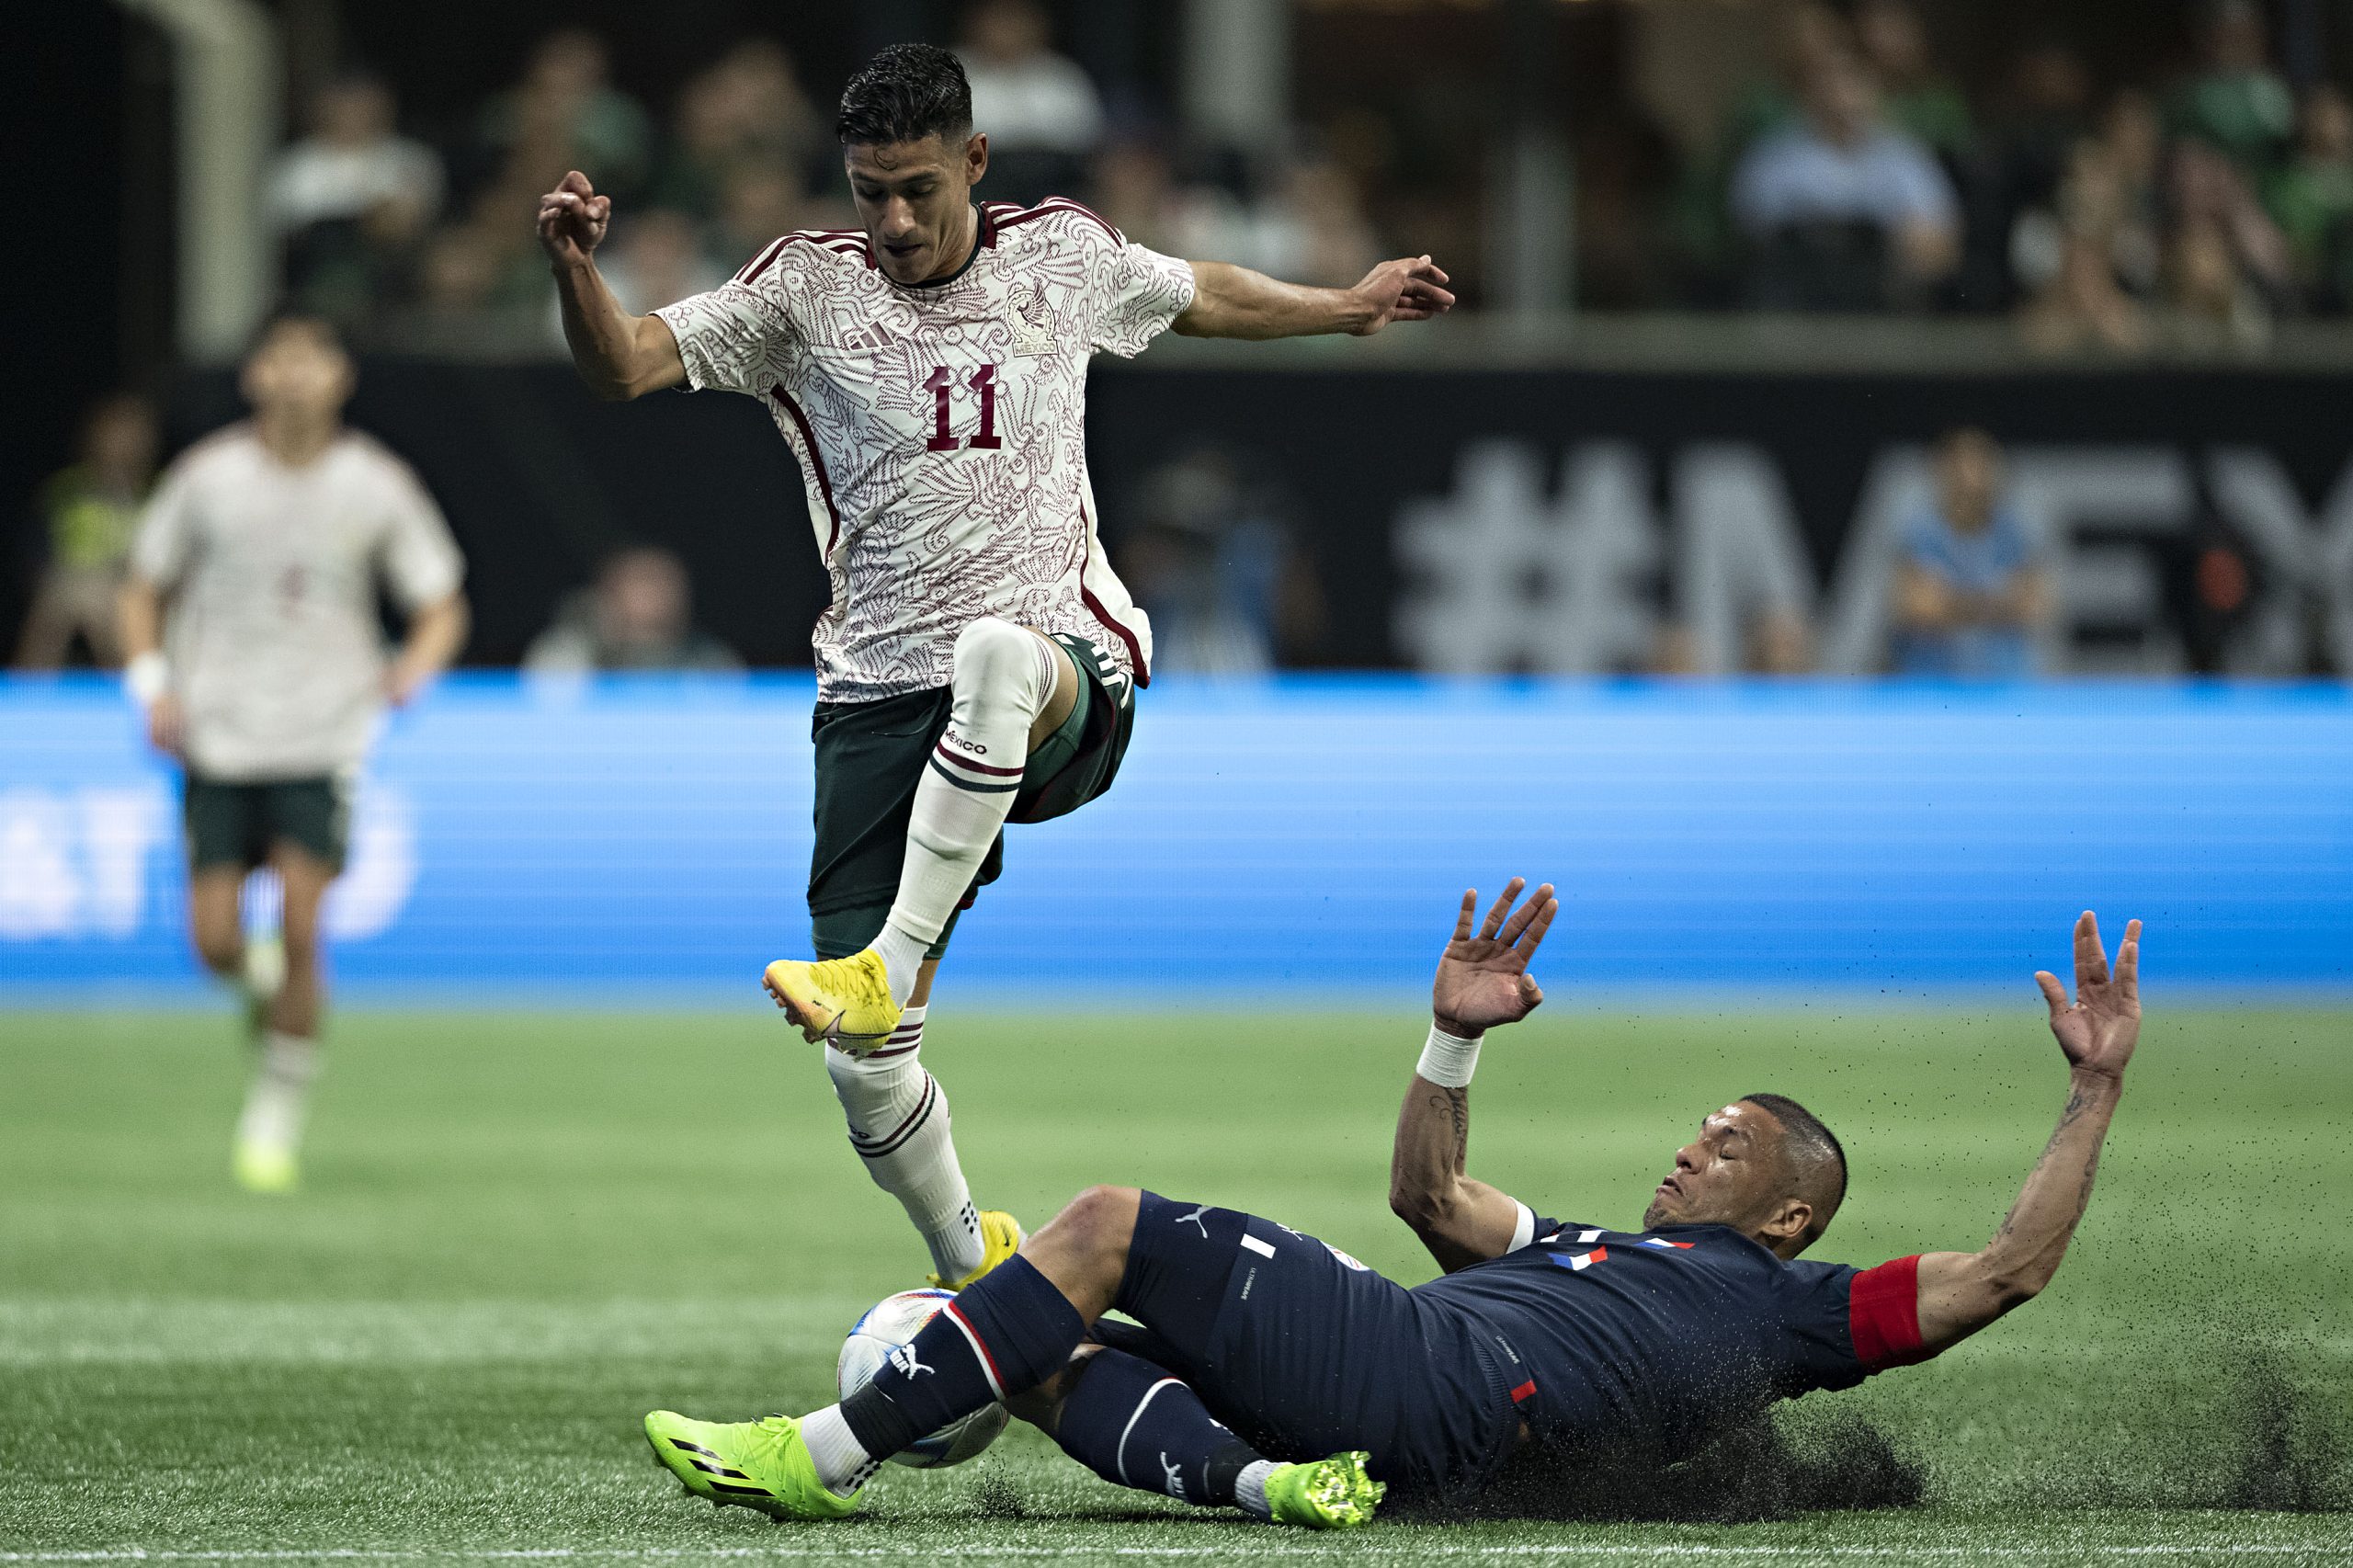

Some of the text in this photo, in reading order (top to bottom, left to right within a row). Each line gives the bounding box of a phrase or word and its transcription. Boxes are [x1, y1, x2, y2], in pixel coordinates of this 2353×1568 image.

[1015, 342, 1056, 355] MÉXICO
[922, 363, 1002, 452] 11
[944, 728, 988, 756] MÉXICO
